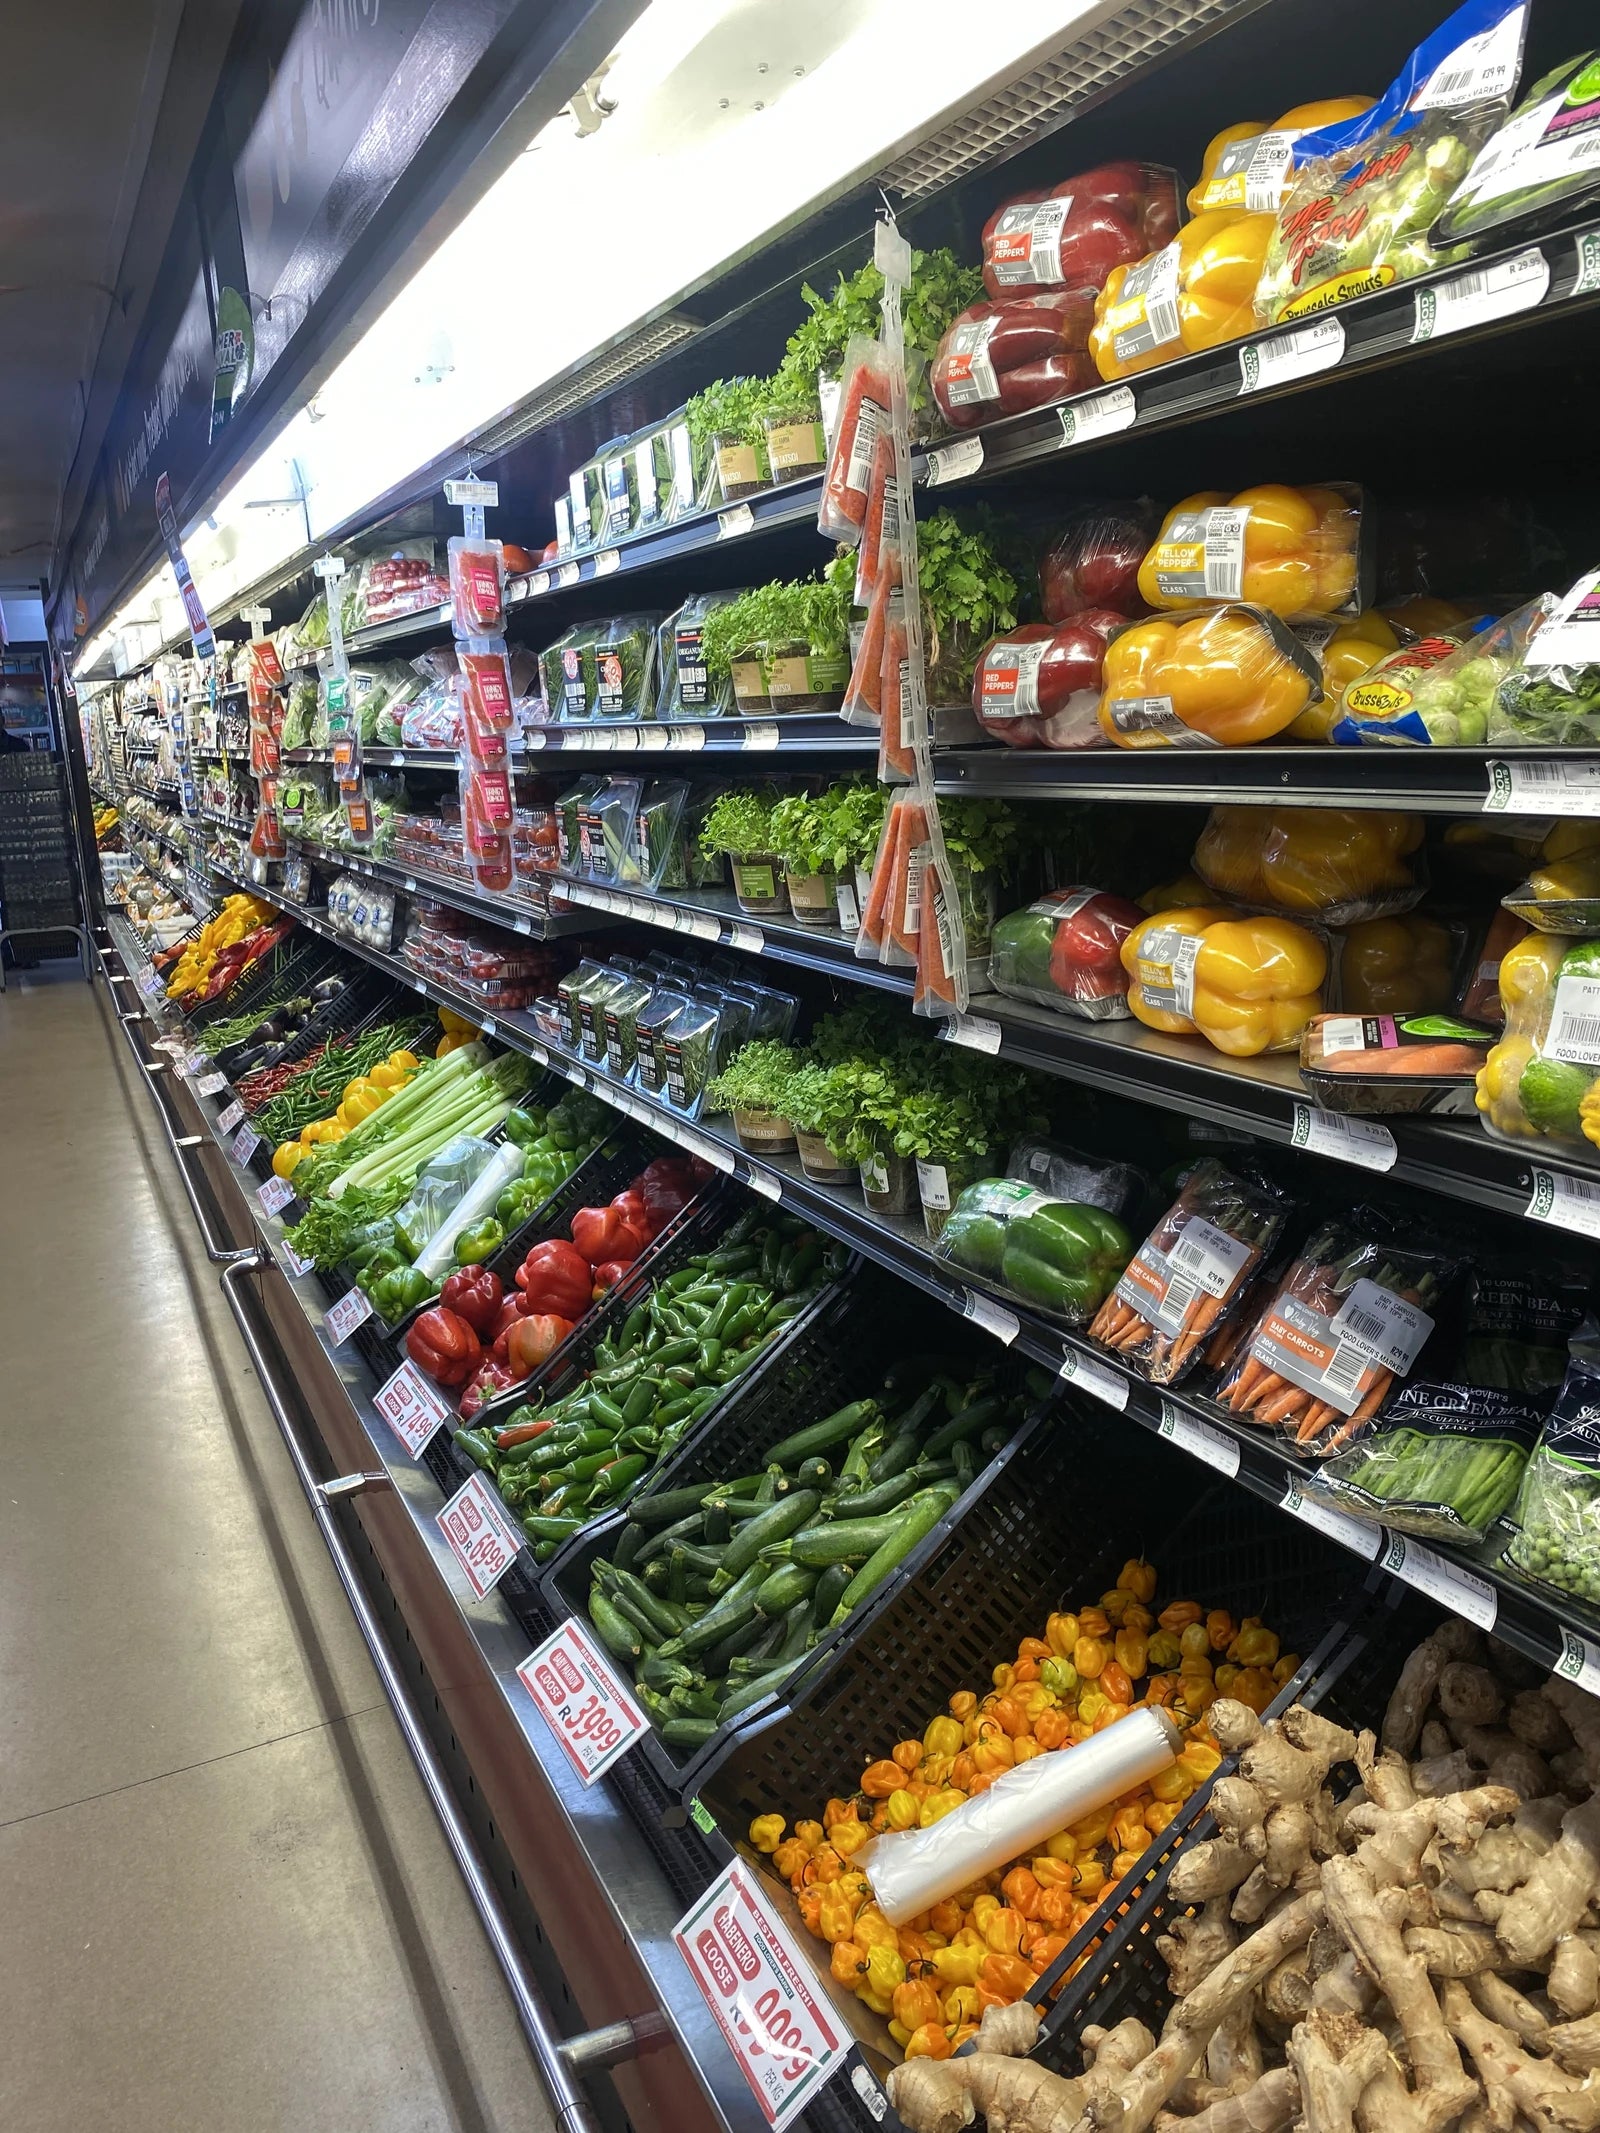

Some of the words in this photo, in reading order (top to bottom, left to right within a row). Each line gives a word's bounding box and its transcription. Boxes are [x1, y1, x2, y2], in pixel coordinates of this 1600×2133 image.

[995, 240, 1010, 249] RED
[995, 247, 1025, 258] PEPPERS
[1418, 296, 1429, 341] FOOD
[1117, 347, 1135, 358] CLASS
[1158, 558, 1198, 568] PEPPERS
[1159, 548, 1196, 558] YELLOW
[1161, 586, 1183, 594] CLASS
[985, 673, 999, 682] RED
[985, 681, 1014, 691] PEPPERS
[1490, 768, 1504, 808] FOOD
[1499, 769, 1511, 808] LOVER'S
[1555, 1049, 1578, 1060] FOOD
[1296, 1109, 1305, 1144] FOOD
[1533, 1176, 1547, 1215] FOOD
[1541, 1178, 1553, 1217] LOVER'S
[1131, 1262, 1143, 1275] BABY
[1142, 1271, 1163, 1290] CARRO
[1171, 1260, 1184, 1273] FOOD
[1183, 1268, 1200, 1284] LOVER'S
[1199, 1278, 1220, 1297] MARKET
[1207, 1271, 1225, 1286] R29.99
[1117, 1287, 1131, 1301] CLASS
[1378, 1294, 1393, 1307] BABY
[1394, 1303, 1417, 1319] CARROTS
[1478, 1291, 1523, 1305] REEN
[1527, 1297, 1583, 1318] BEAS
[1374, 1300, 1388, 1310] WITH
[1388, 1307, 1403, 1319] TOPS
[1290, 1310, 1306, 1331] Baby
[1307, 1321, 1320, 1338] Veg
[1260, 1337, 1272, 1350] 200
[1270, 1320, 1287, 1336] BABY
[1286, 1331, 1326, 1359] CARROTS
[1340, 1330, 1357, 1344] FOOD
[1355, 1339, 1379, 1359] LOVER'S
[1378, 1353, 1404, 1373] MARKET
[1254, 1350, 1272, 1366] CLASS
[1389, 1346, 1410, 1362] R29.99
[1442, 1382, 1468, 1393] FOOD
[1469, 1388, 1509, 1402] LOVER'S
[386, 1396, 399, 1416] LOOSE
[1433, 1395, 1494, 1417] GREEN
[1388, 1533, 1404, 1568] FOOD
[1563, 1636, 1577, 1672] FOOD
[539, 1670, 562, 1701] LOOSE
[581, 1647, 595, 1666] BEST
[600, 1675, 624, 1705] FRESH!
[716, 1911, 757, 1974] HABENERO
[703, 1939, 735, 1990] LOOSE
[752, 1908, 772, 1943] BEST
[771, 1942, 785, 1962] IN
[782, 1957, 814, 2009] FRESH!
[754, 1933, 766, 1951] FOOD
[763, 1947, 780, 1977] LOVER'S
[777, 1973, 795, 2000] MARKET
[763, 2068, 778, 2091] PER
[774, 2084, 785, 2102] KG
